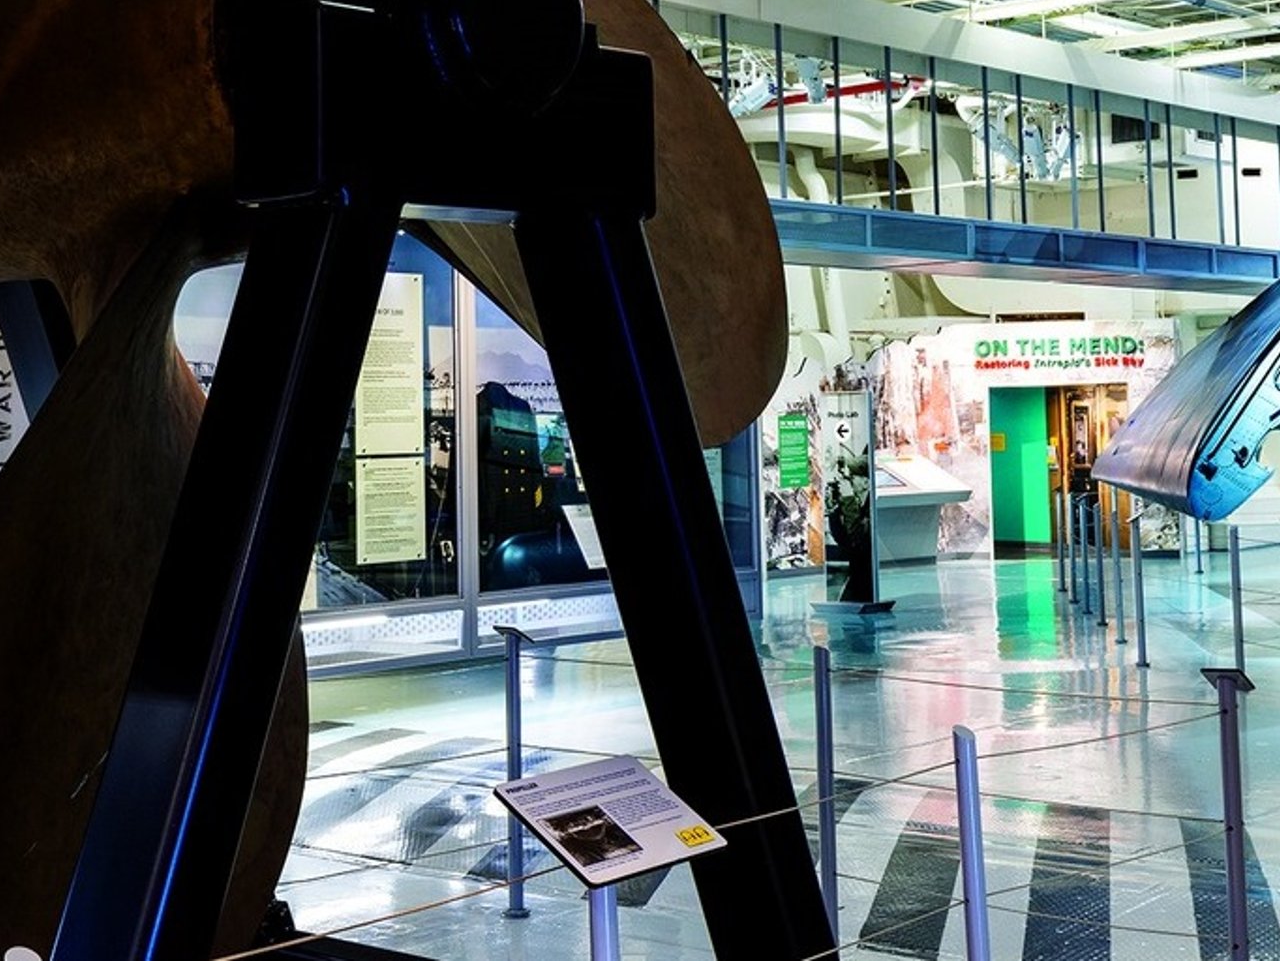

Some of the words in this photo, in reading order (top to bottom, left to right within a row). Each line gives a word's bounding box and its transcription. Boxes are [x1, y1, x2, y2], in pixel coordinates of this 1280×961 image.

[974, 339, 1008, 358] ON
[1016, 338, 1060, 357] THE
[1069, 336, 1145, 356] MEND:
[974, 359, 1030, 370] Restoring
[1033, 358, 1091, 370] Intrepid's
[1094, 357, 1119, 368] Sick
